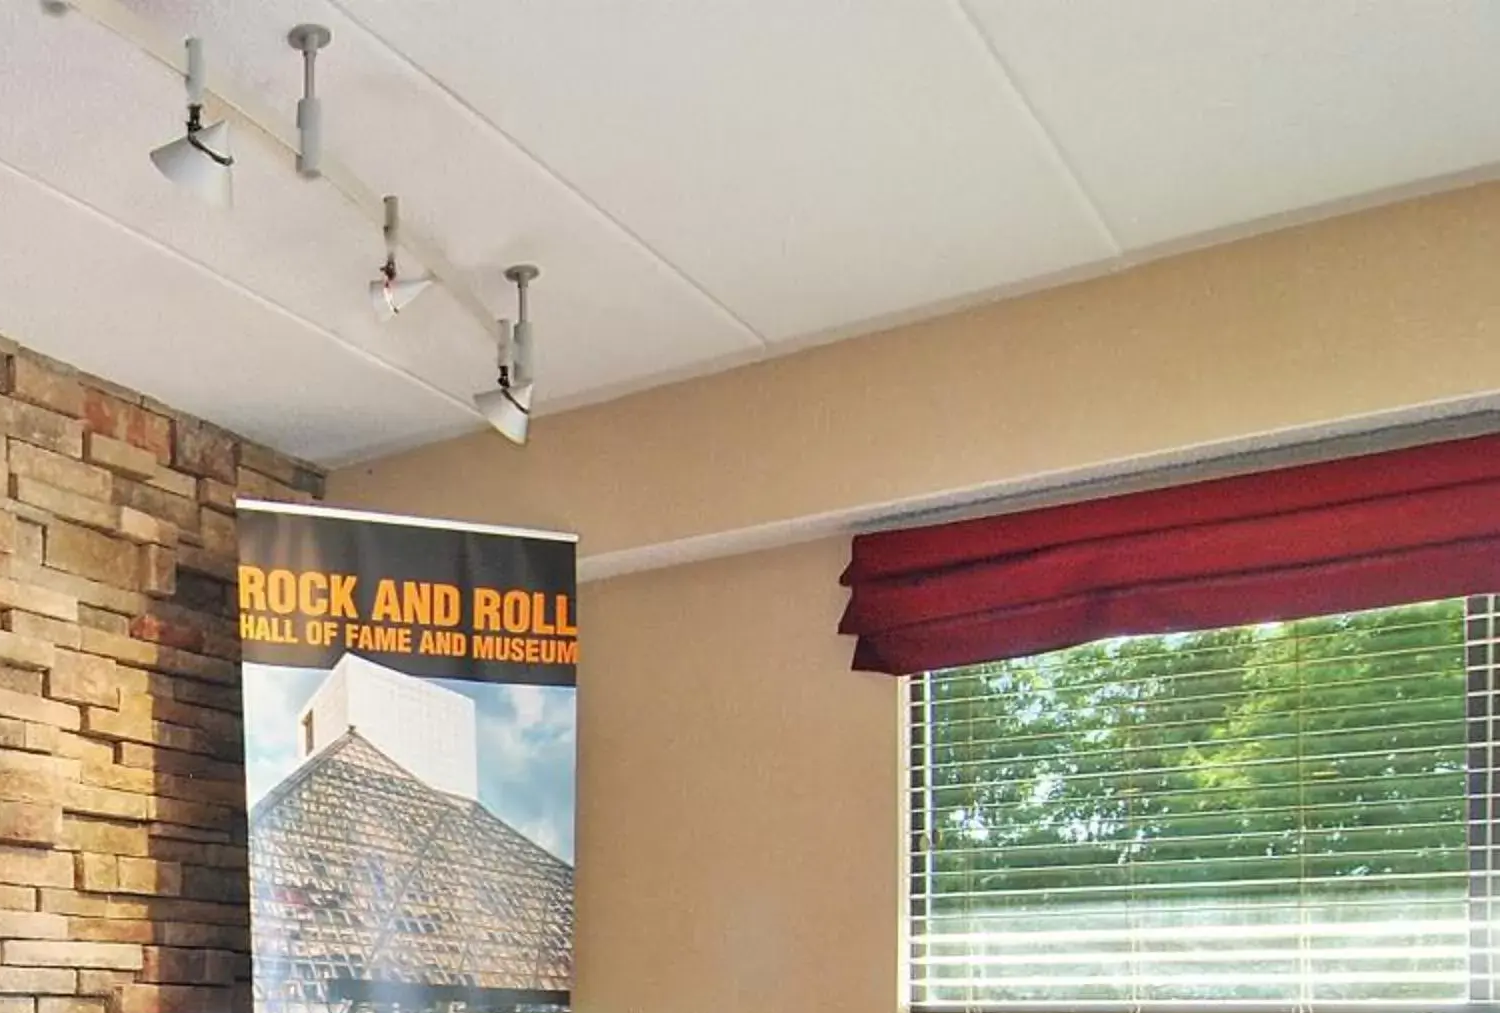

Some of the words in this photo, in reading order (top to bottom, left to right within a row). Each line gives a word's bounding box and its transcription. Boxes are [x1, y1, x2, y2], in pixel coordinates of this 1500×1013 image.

[238, 565, 359, 619] ROCK
[371, 579, 461, 628] AND
[473, 588, 578, 636] ROLL
[239, 613, 299, 643] HALL
[306, 621, 338, 646] OF
[345, 623, 412, 654] FAME
[419, 630, 467, 657] AND
[473, 635, 578, 664] MUSEUM
